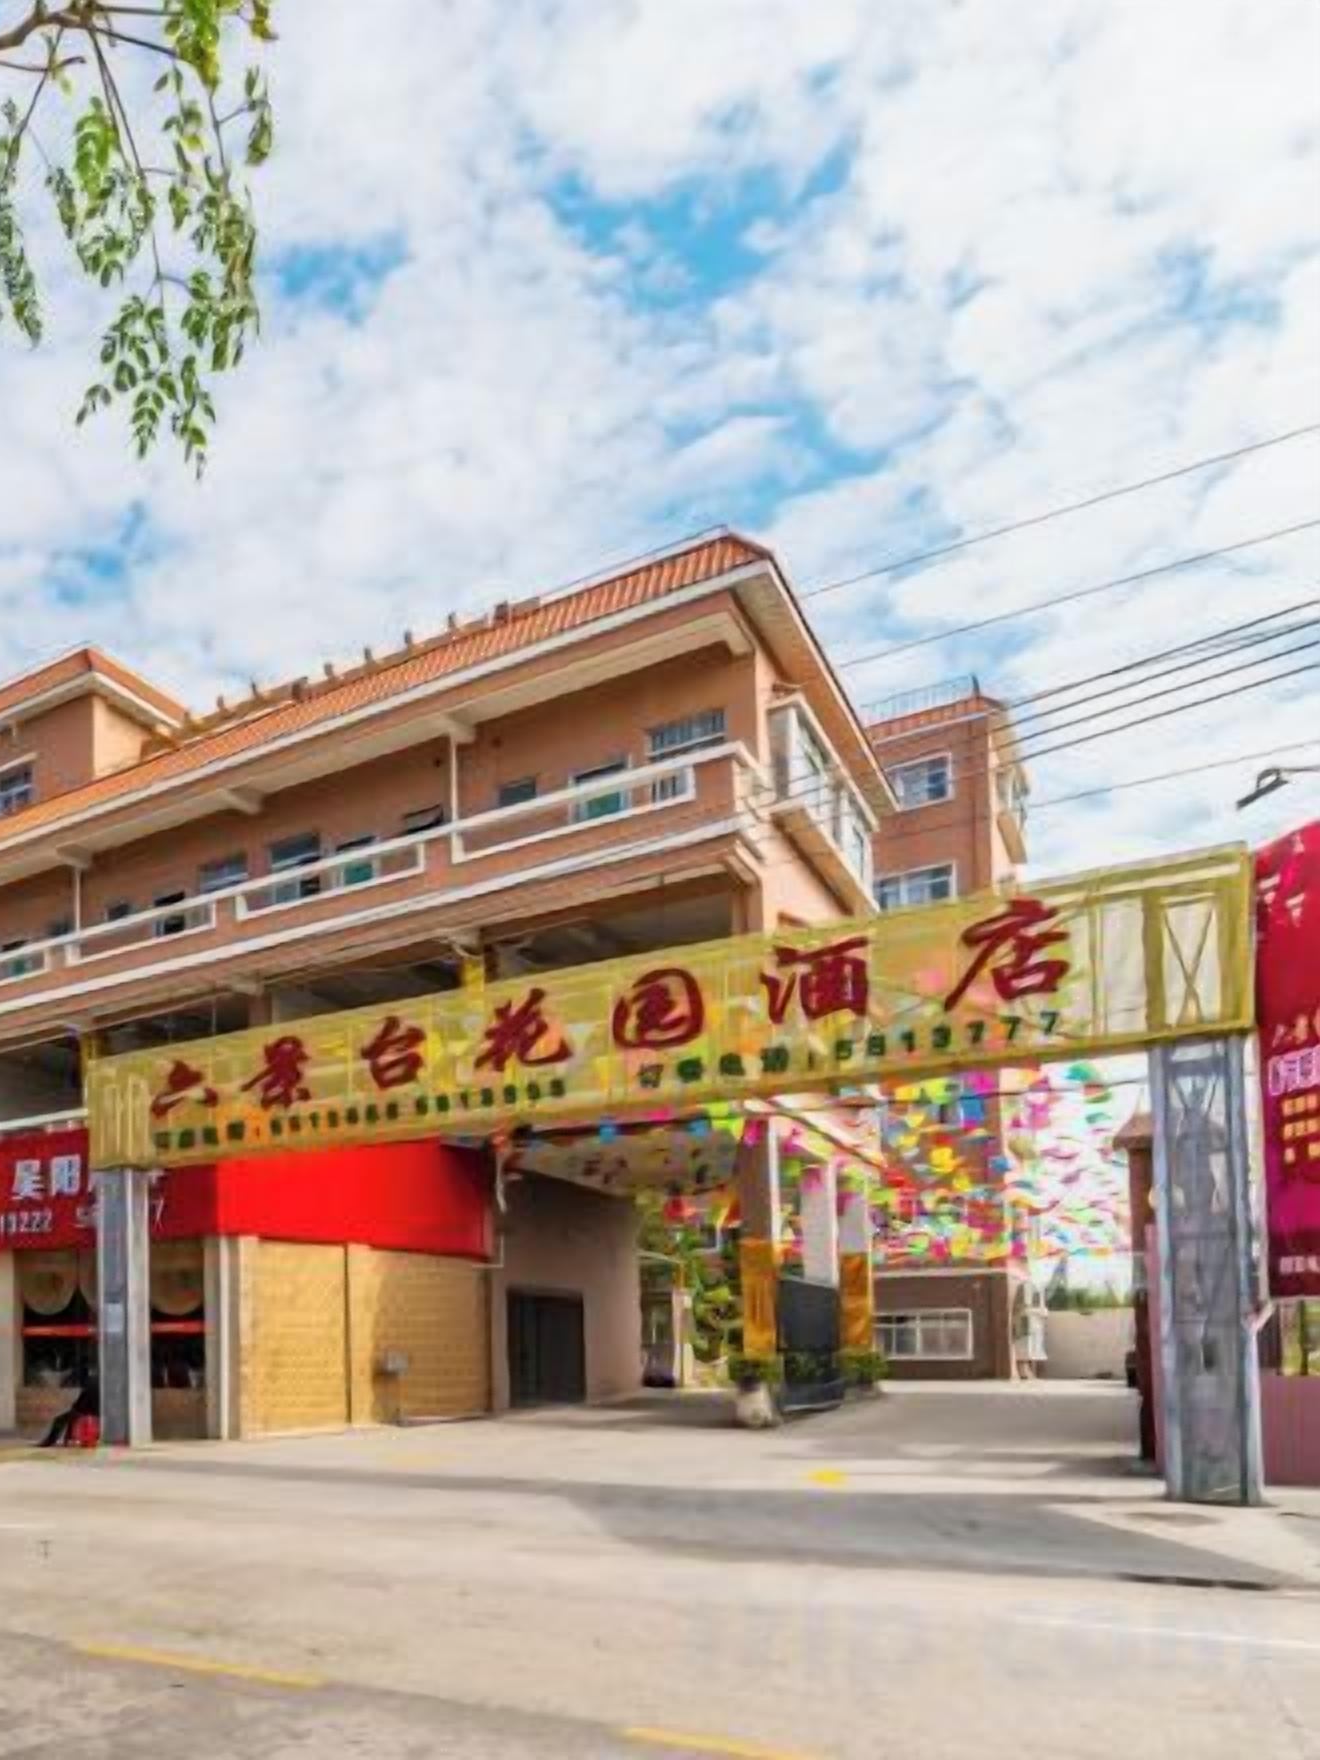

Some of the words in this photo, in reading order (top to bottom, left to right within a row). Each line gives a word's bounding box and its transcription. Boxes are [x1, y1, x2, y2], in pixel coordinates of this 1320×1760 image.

[151, 896, 1070, 1120] 六景台花园酒店
